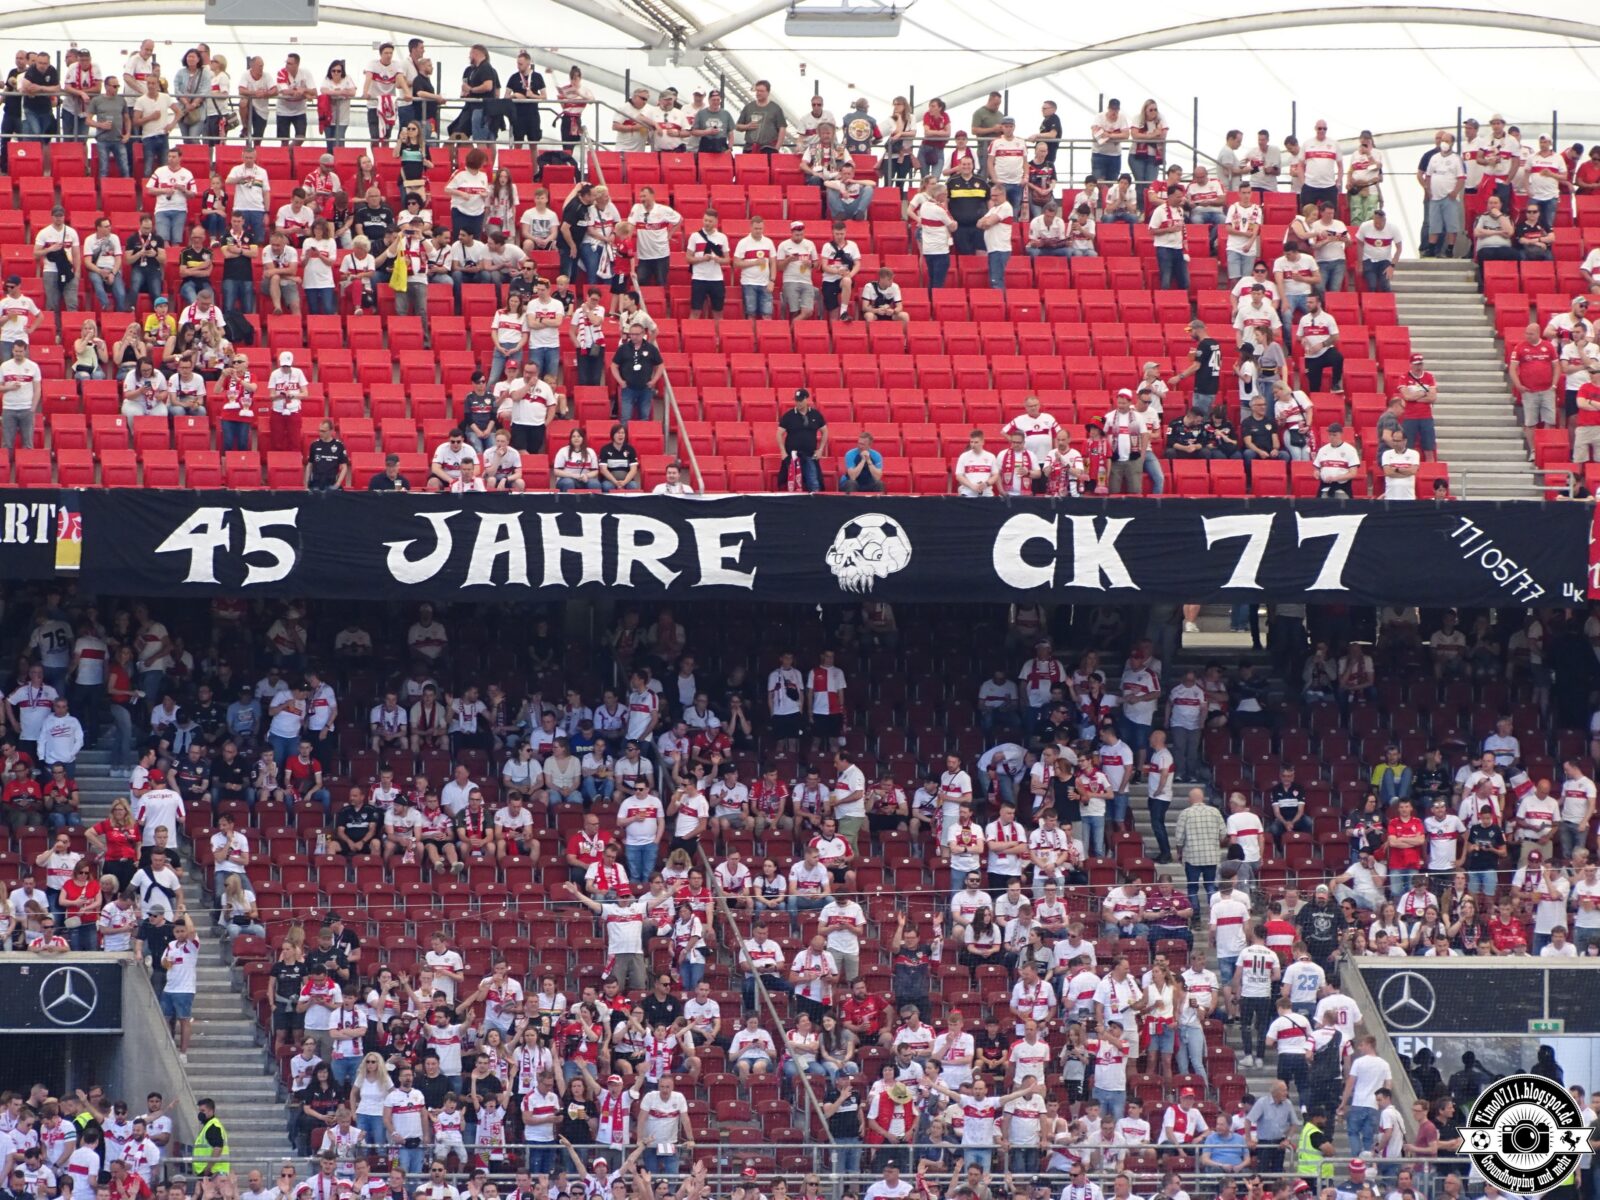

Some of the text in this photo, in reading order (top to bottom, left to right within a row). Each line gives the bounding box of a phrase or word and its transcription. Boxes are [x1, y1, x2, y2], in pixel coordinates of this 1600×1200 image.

[0, 503, 56, 544] RT
[154, 507, 299, 587] 45
[382, 510, 757, 589] JAHRE
[992, 512, 1140, 591] CK
[1202, 512, 1368, 591] 77
[1563, 582, 1584, 602] UK
[42, 628, 66, 649] 76
[1252, 955, 1265, 976] 11
[1297, 974, 1319, 990] 23
